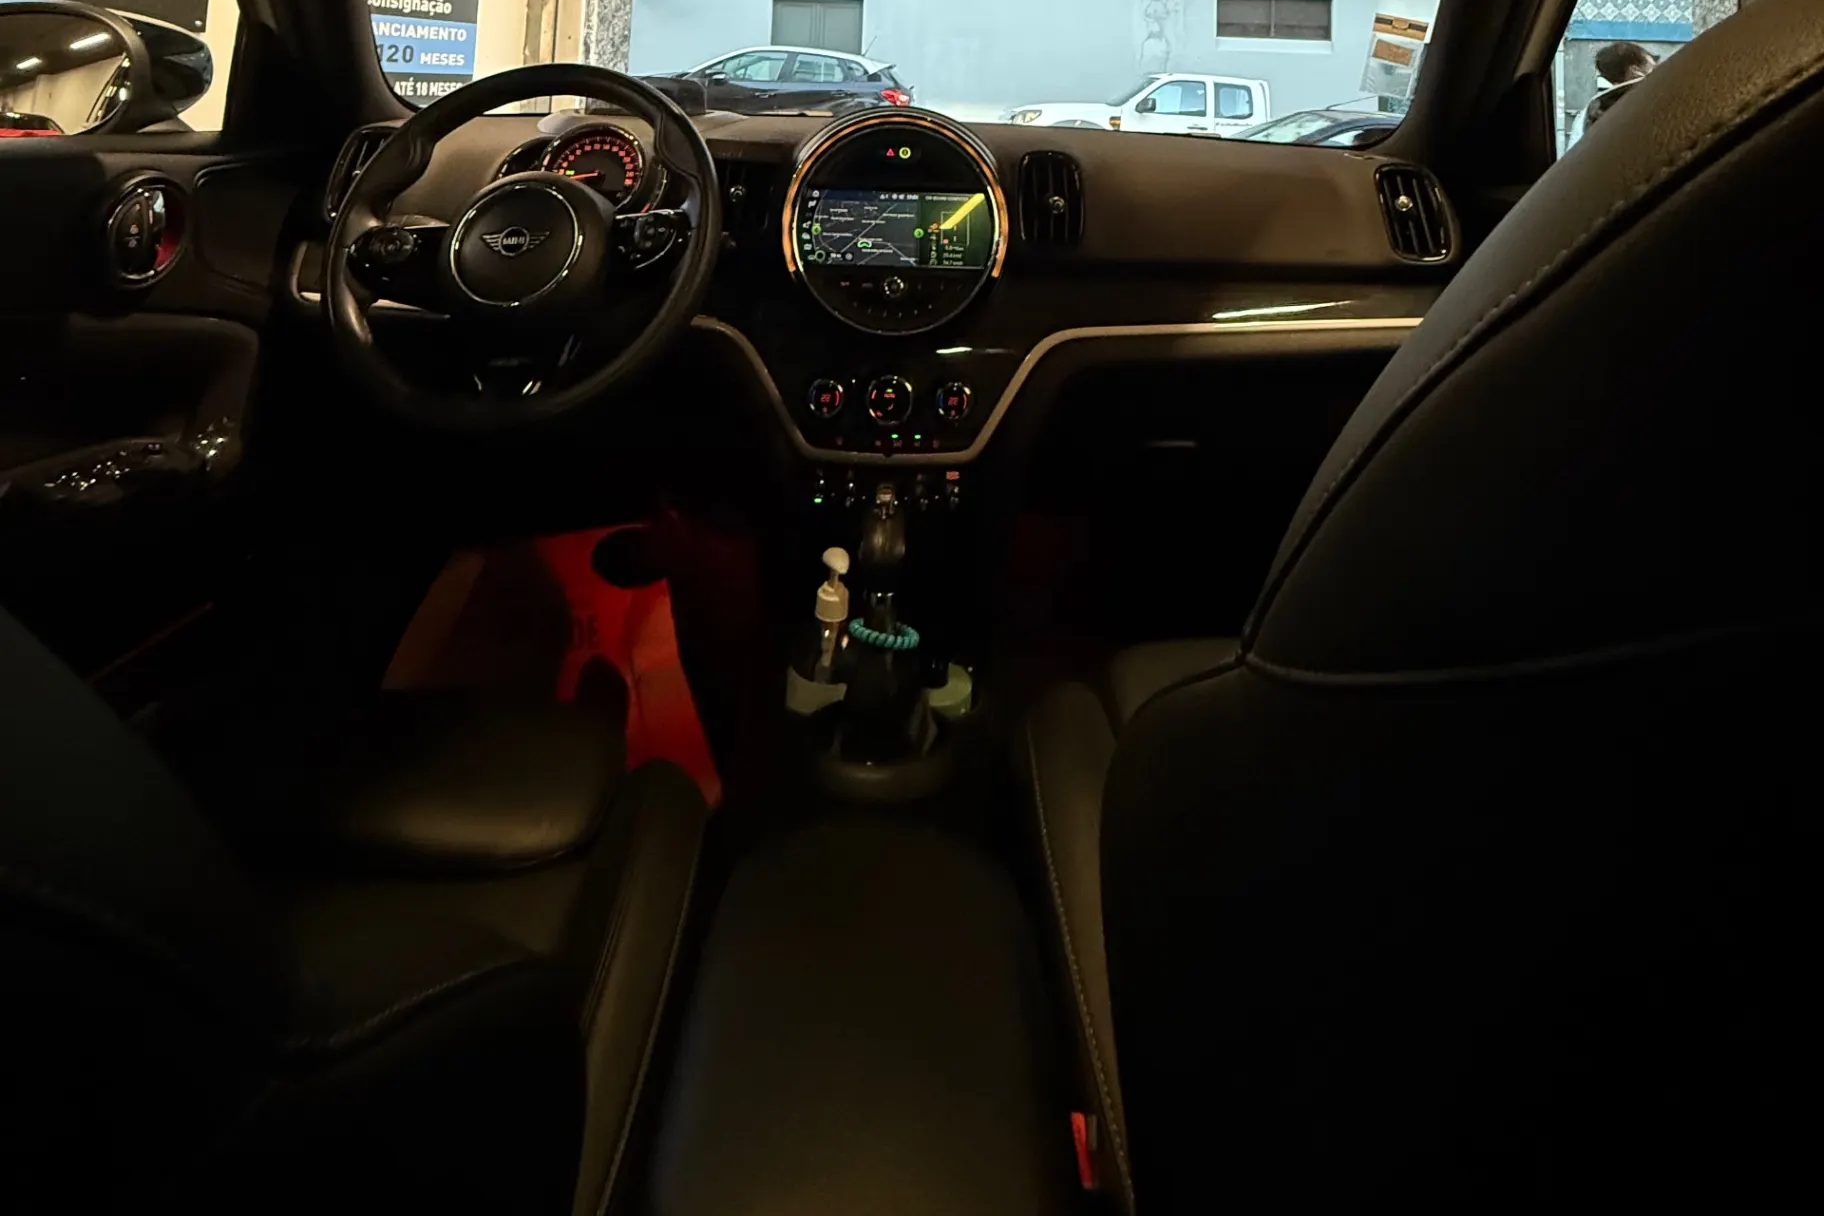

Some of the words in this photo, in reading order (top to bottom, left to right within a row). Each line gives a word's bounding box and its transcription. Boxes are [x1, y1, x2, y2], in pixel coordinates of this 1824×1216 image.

[420, 53, 465, 66] MESES
[393, 77, 415, 96] ATÉ
[416, 82, 428, 96] 18
